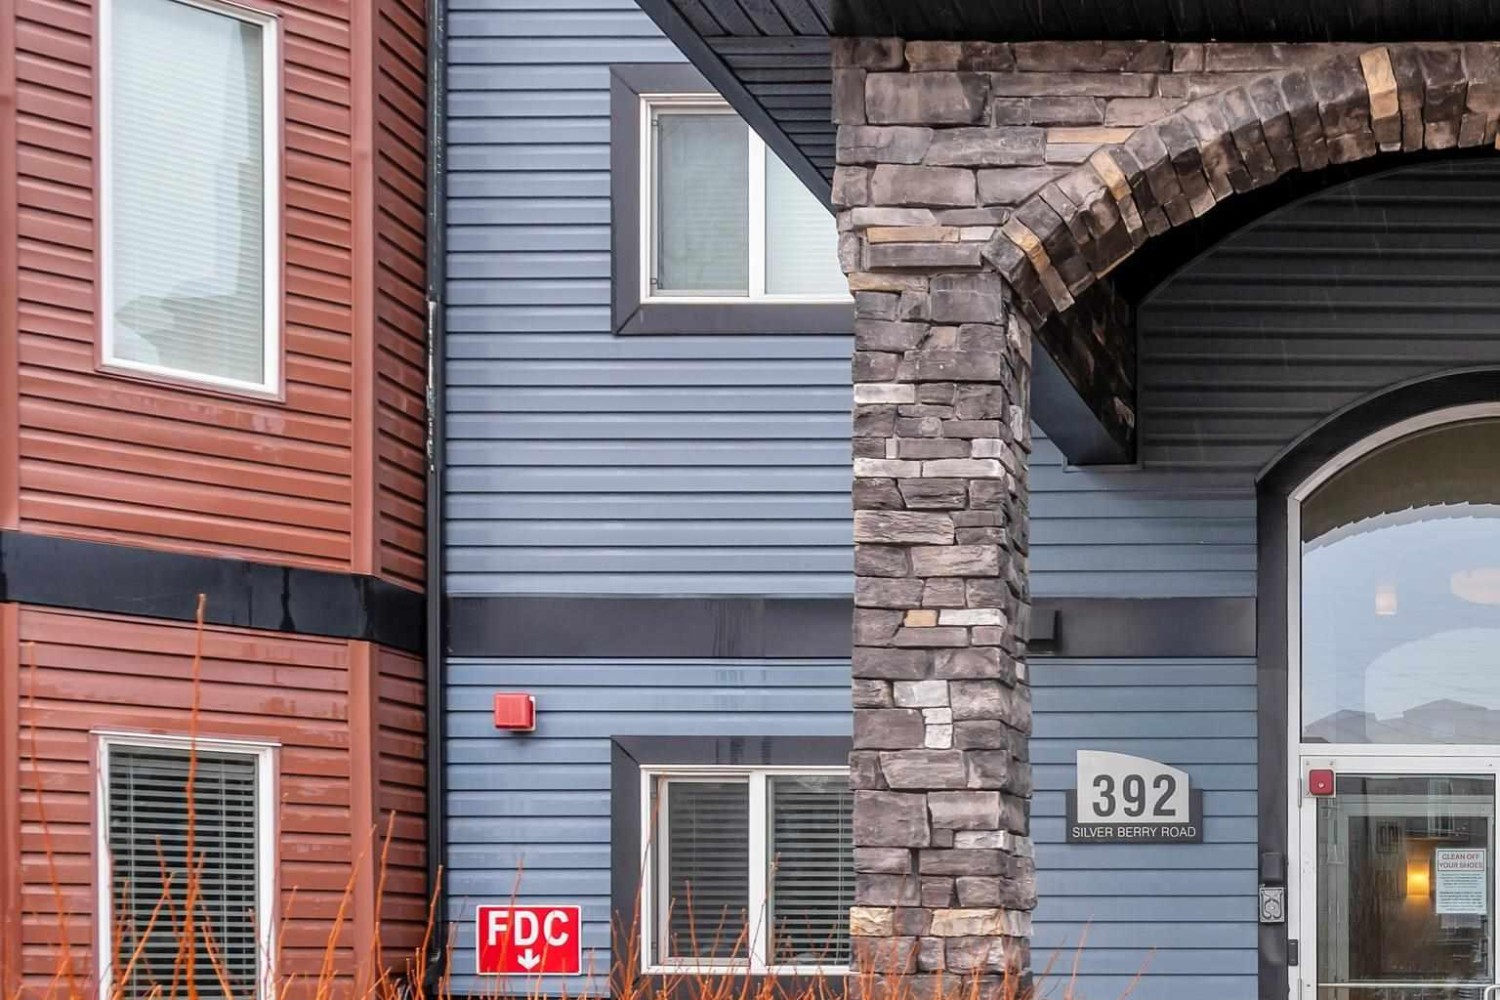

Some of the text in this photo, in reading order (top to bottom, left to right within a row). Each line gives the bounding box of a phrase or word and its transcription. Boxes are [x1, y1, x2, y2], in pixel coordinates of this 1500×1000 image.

[1092, 773, 1176, 817] 392
[1072, 826, 1196, 838] SILVER BERRY ROAD
[488, 910, 569, 946] FDC
